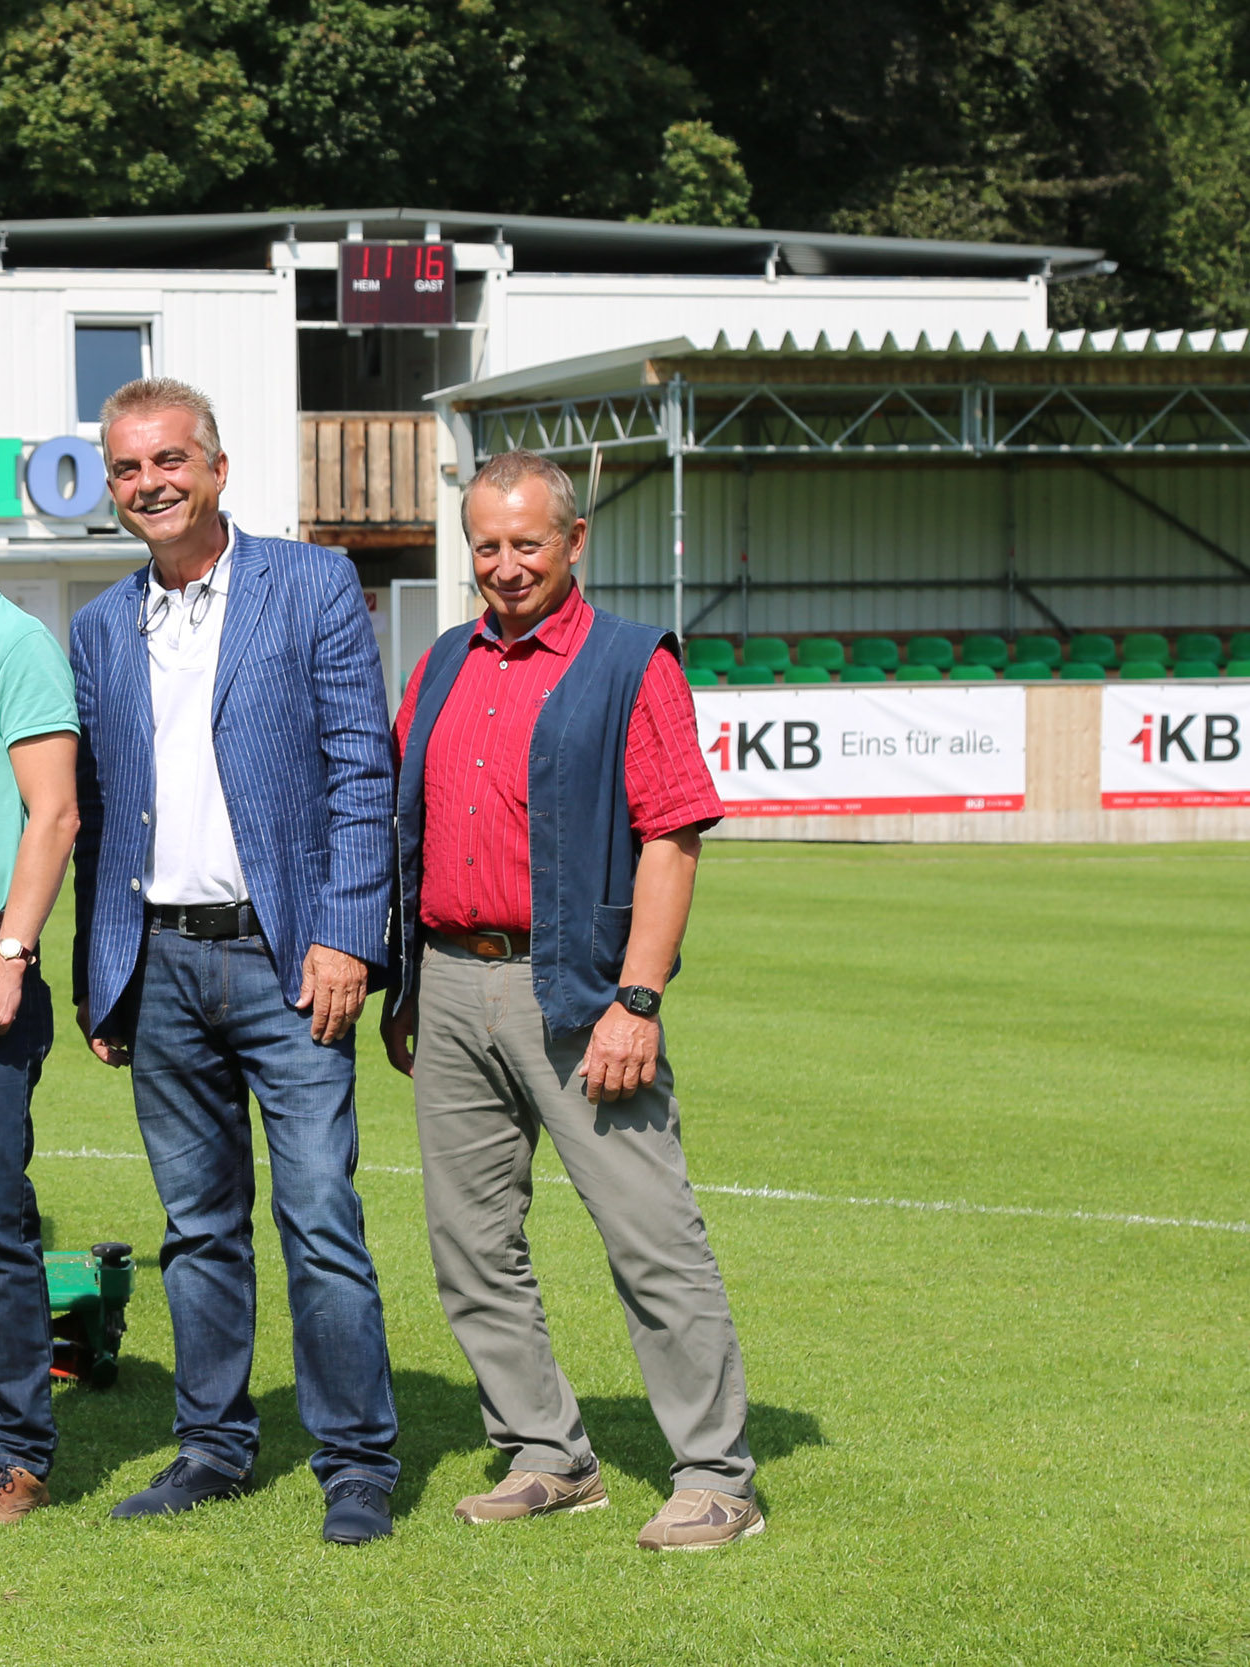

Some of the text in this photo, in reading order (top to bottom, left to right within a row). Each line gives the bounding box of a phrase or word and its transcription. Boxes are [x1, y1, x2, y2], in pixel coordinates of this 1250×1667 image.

[353, 280, 444, 292] HEIM GAST
[842, 731, 897, 756] Eins
[906, 730, 942, 755] für
[949, 729, 1001, 754] alle.
